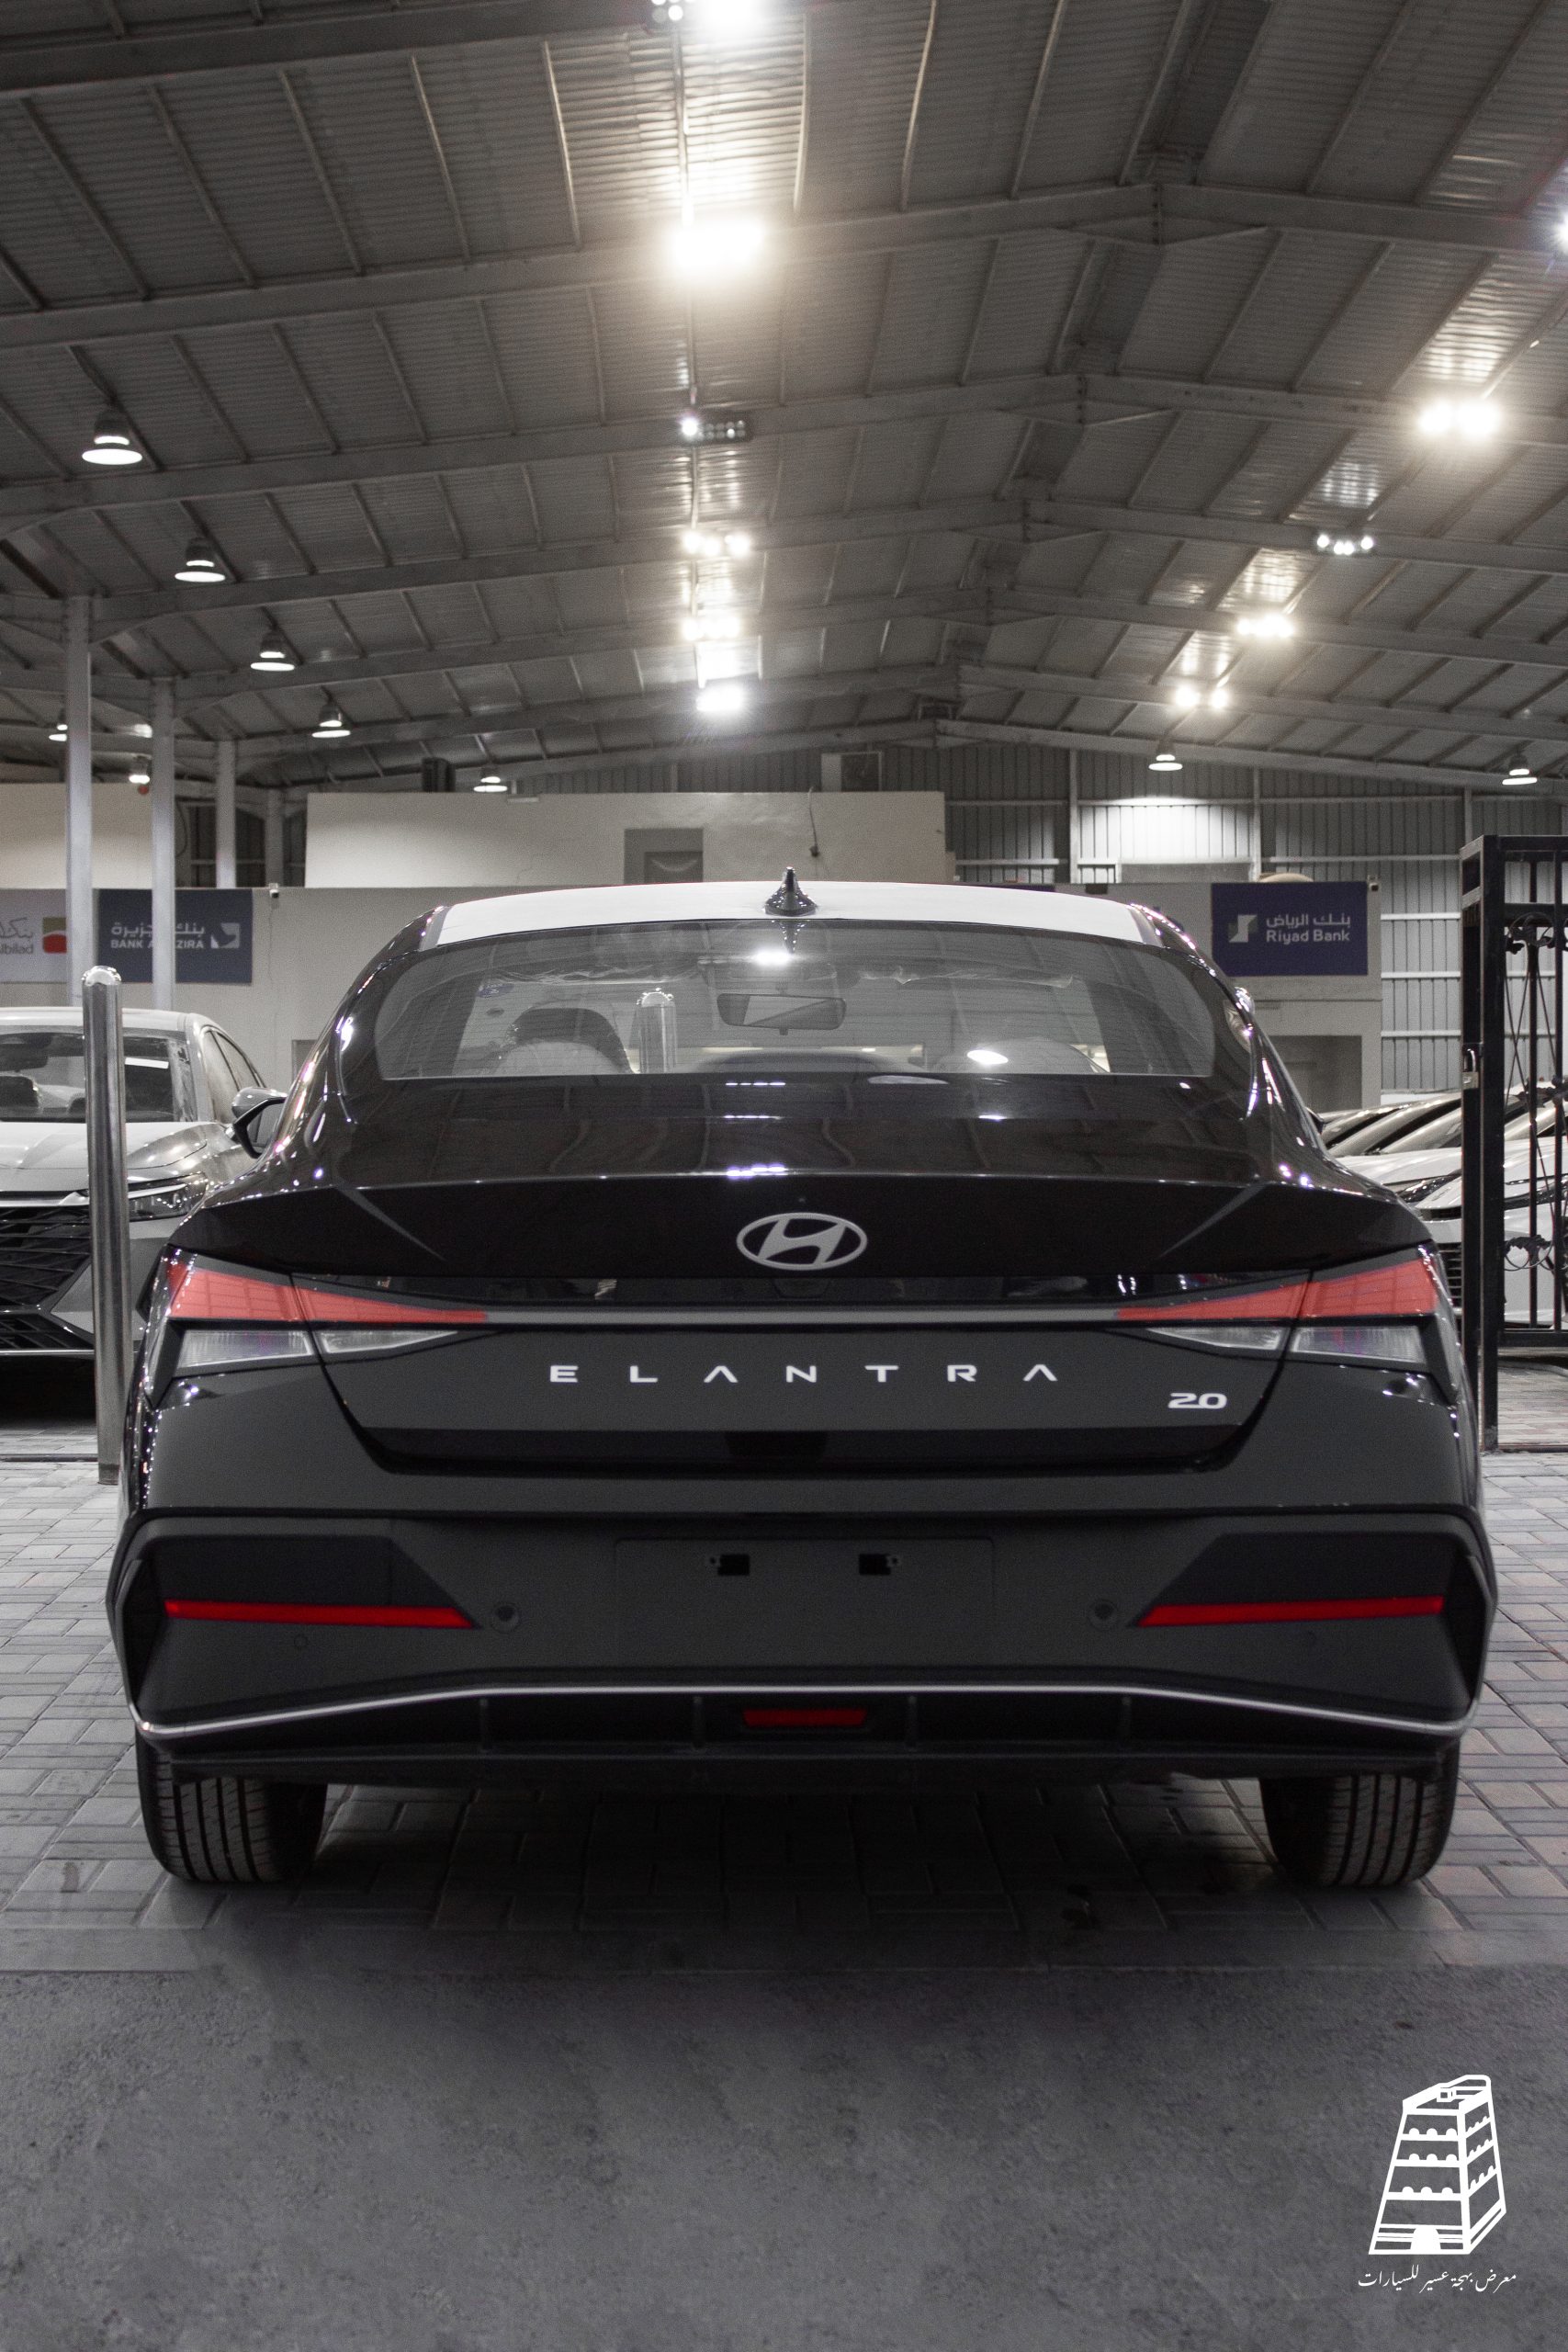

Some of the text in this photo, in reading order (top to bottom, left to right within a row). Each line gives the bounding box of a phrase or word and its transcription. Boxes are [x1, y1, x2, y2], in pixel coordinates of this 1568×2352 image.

[1266, 912, 1351, 929] بنك الرياض
[110, 939, 143, 949] BANK
[1266, 929, 1350, 945] Riyad Bank
[549, 1363, 1057, 1384] ELANTRA
